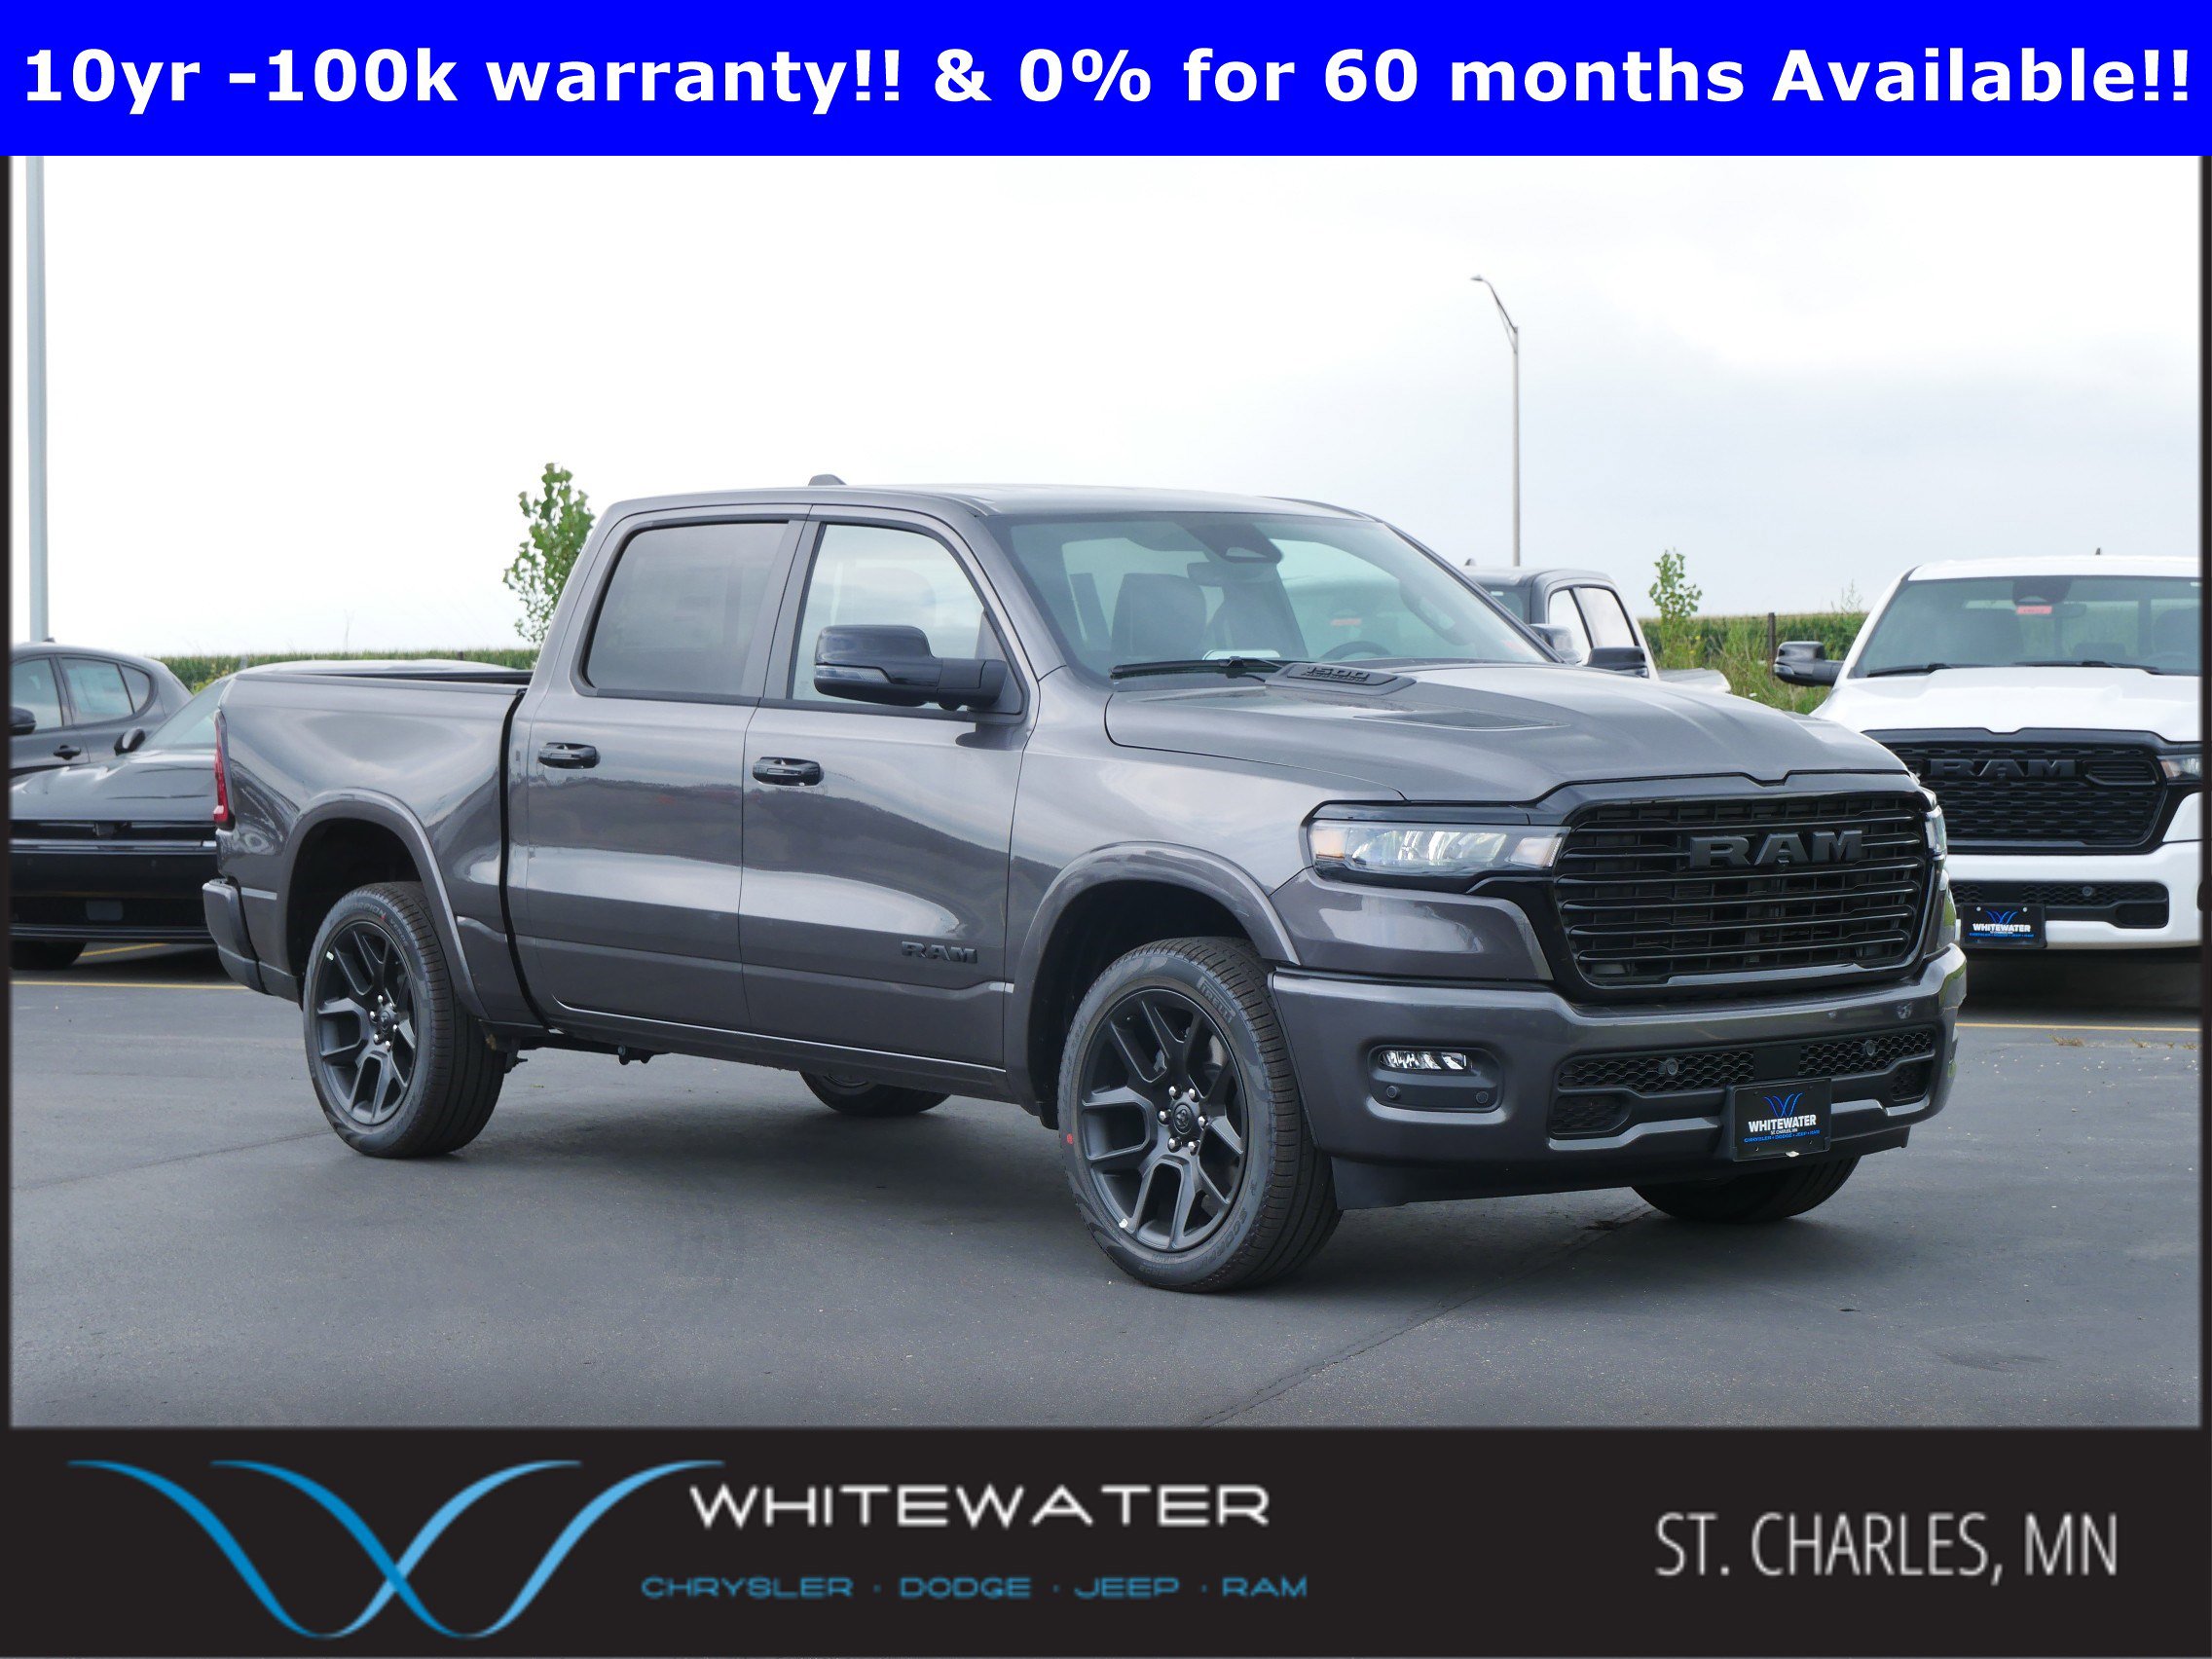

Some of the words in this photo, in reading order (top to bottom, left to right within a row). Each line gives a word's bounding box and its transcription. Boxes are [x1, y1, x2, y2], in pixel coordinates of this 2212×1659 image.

[1930, 757, 2077, 778] RAM
[1689, 829, 1862, 869] RAM
[1972, 923, 2032, 933] WHITEWATER
[901, 940, 978, 964] RAM
[1748, 1114, 1817, 1133] WHITEWATER
